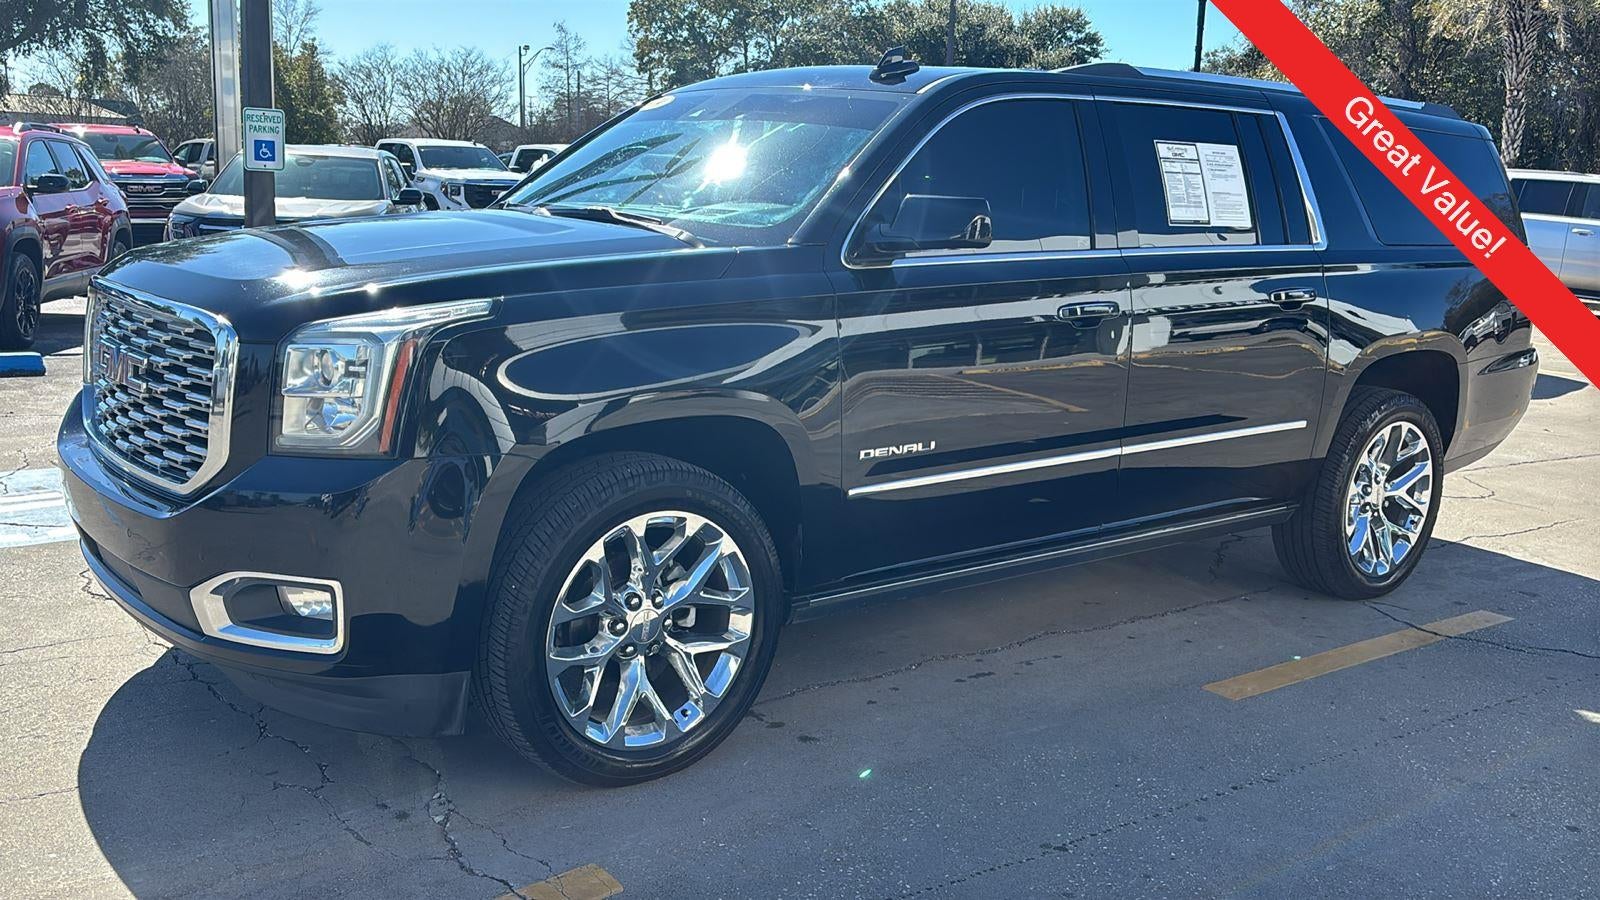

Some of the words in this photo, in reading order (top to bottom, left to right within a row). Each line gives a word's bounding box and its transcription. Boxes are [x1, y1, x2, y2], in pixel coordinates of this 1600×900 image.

[246, 114, 282, 124] RESERVED
[248, 124, 280, 135] PARKING
[127, 185, 162, 193] GMC
[99, 334, 148, 392] GMC
[859, 440, 936, 461] DENALI
